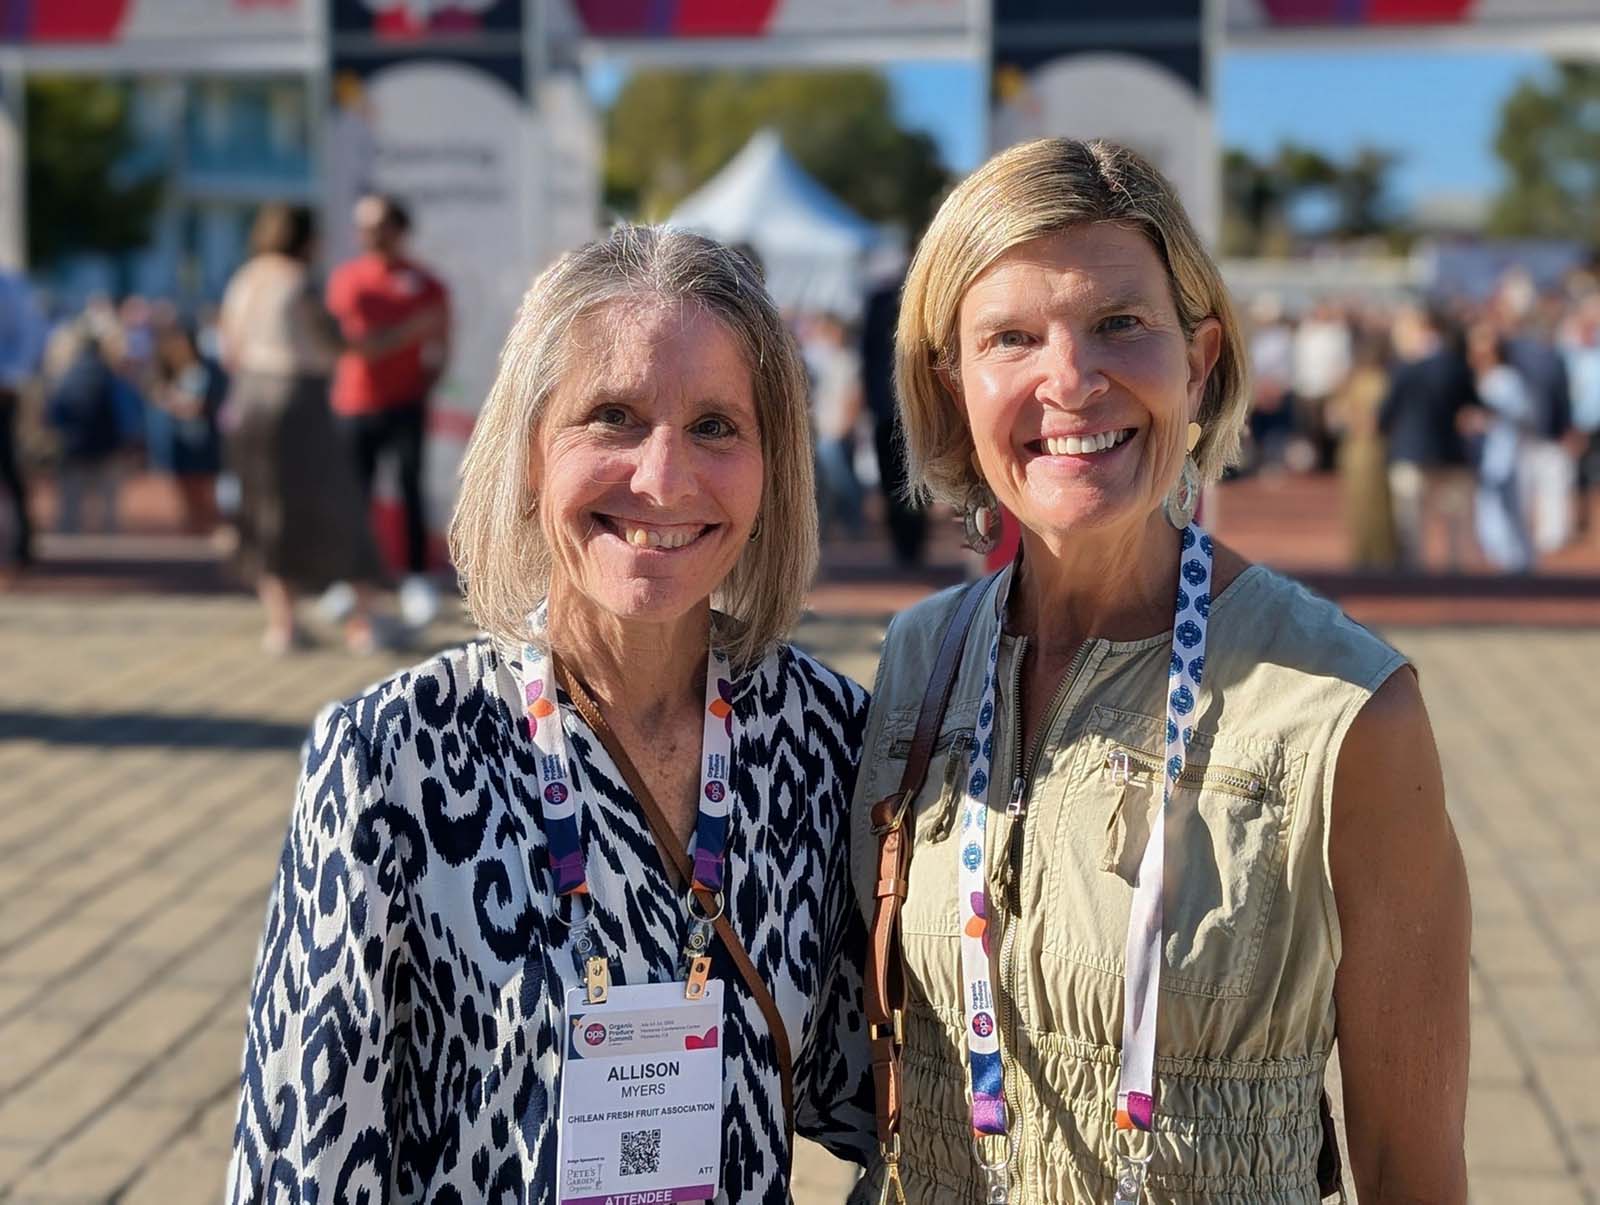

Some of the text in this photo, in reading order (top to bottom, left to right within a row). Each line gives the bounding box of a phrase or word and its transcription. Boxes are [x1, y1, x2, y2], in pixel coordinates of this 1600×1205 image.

[971, 982, 979, 1010] Organic
[979, 1014, 991, 1036] ops
[586, 1030, 605, 1040] ops
[607, 1061, 680, 1081] ALLISON
[621, 1083, 665, 1098] MYERS
[568, 1103, 715, 1124] CHILEAN FRESH FRUIT ASSOCIATION
[698, 1166, 713, 1175] ATT
[605, 1190, 672, 1205] ATTENDEE
